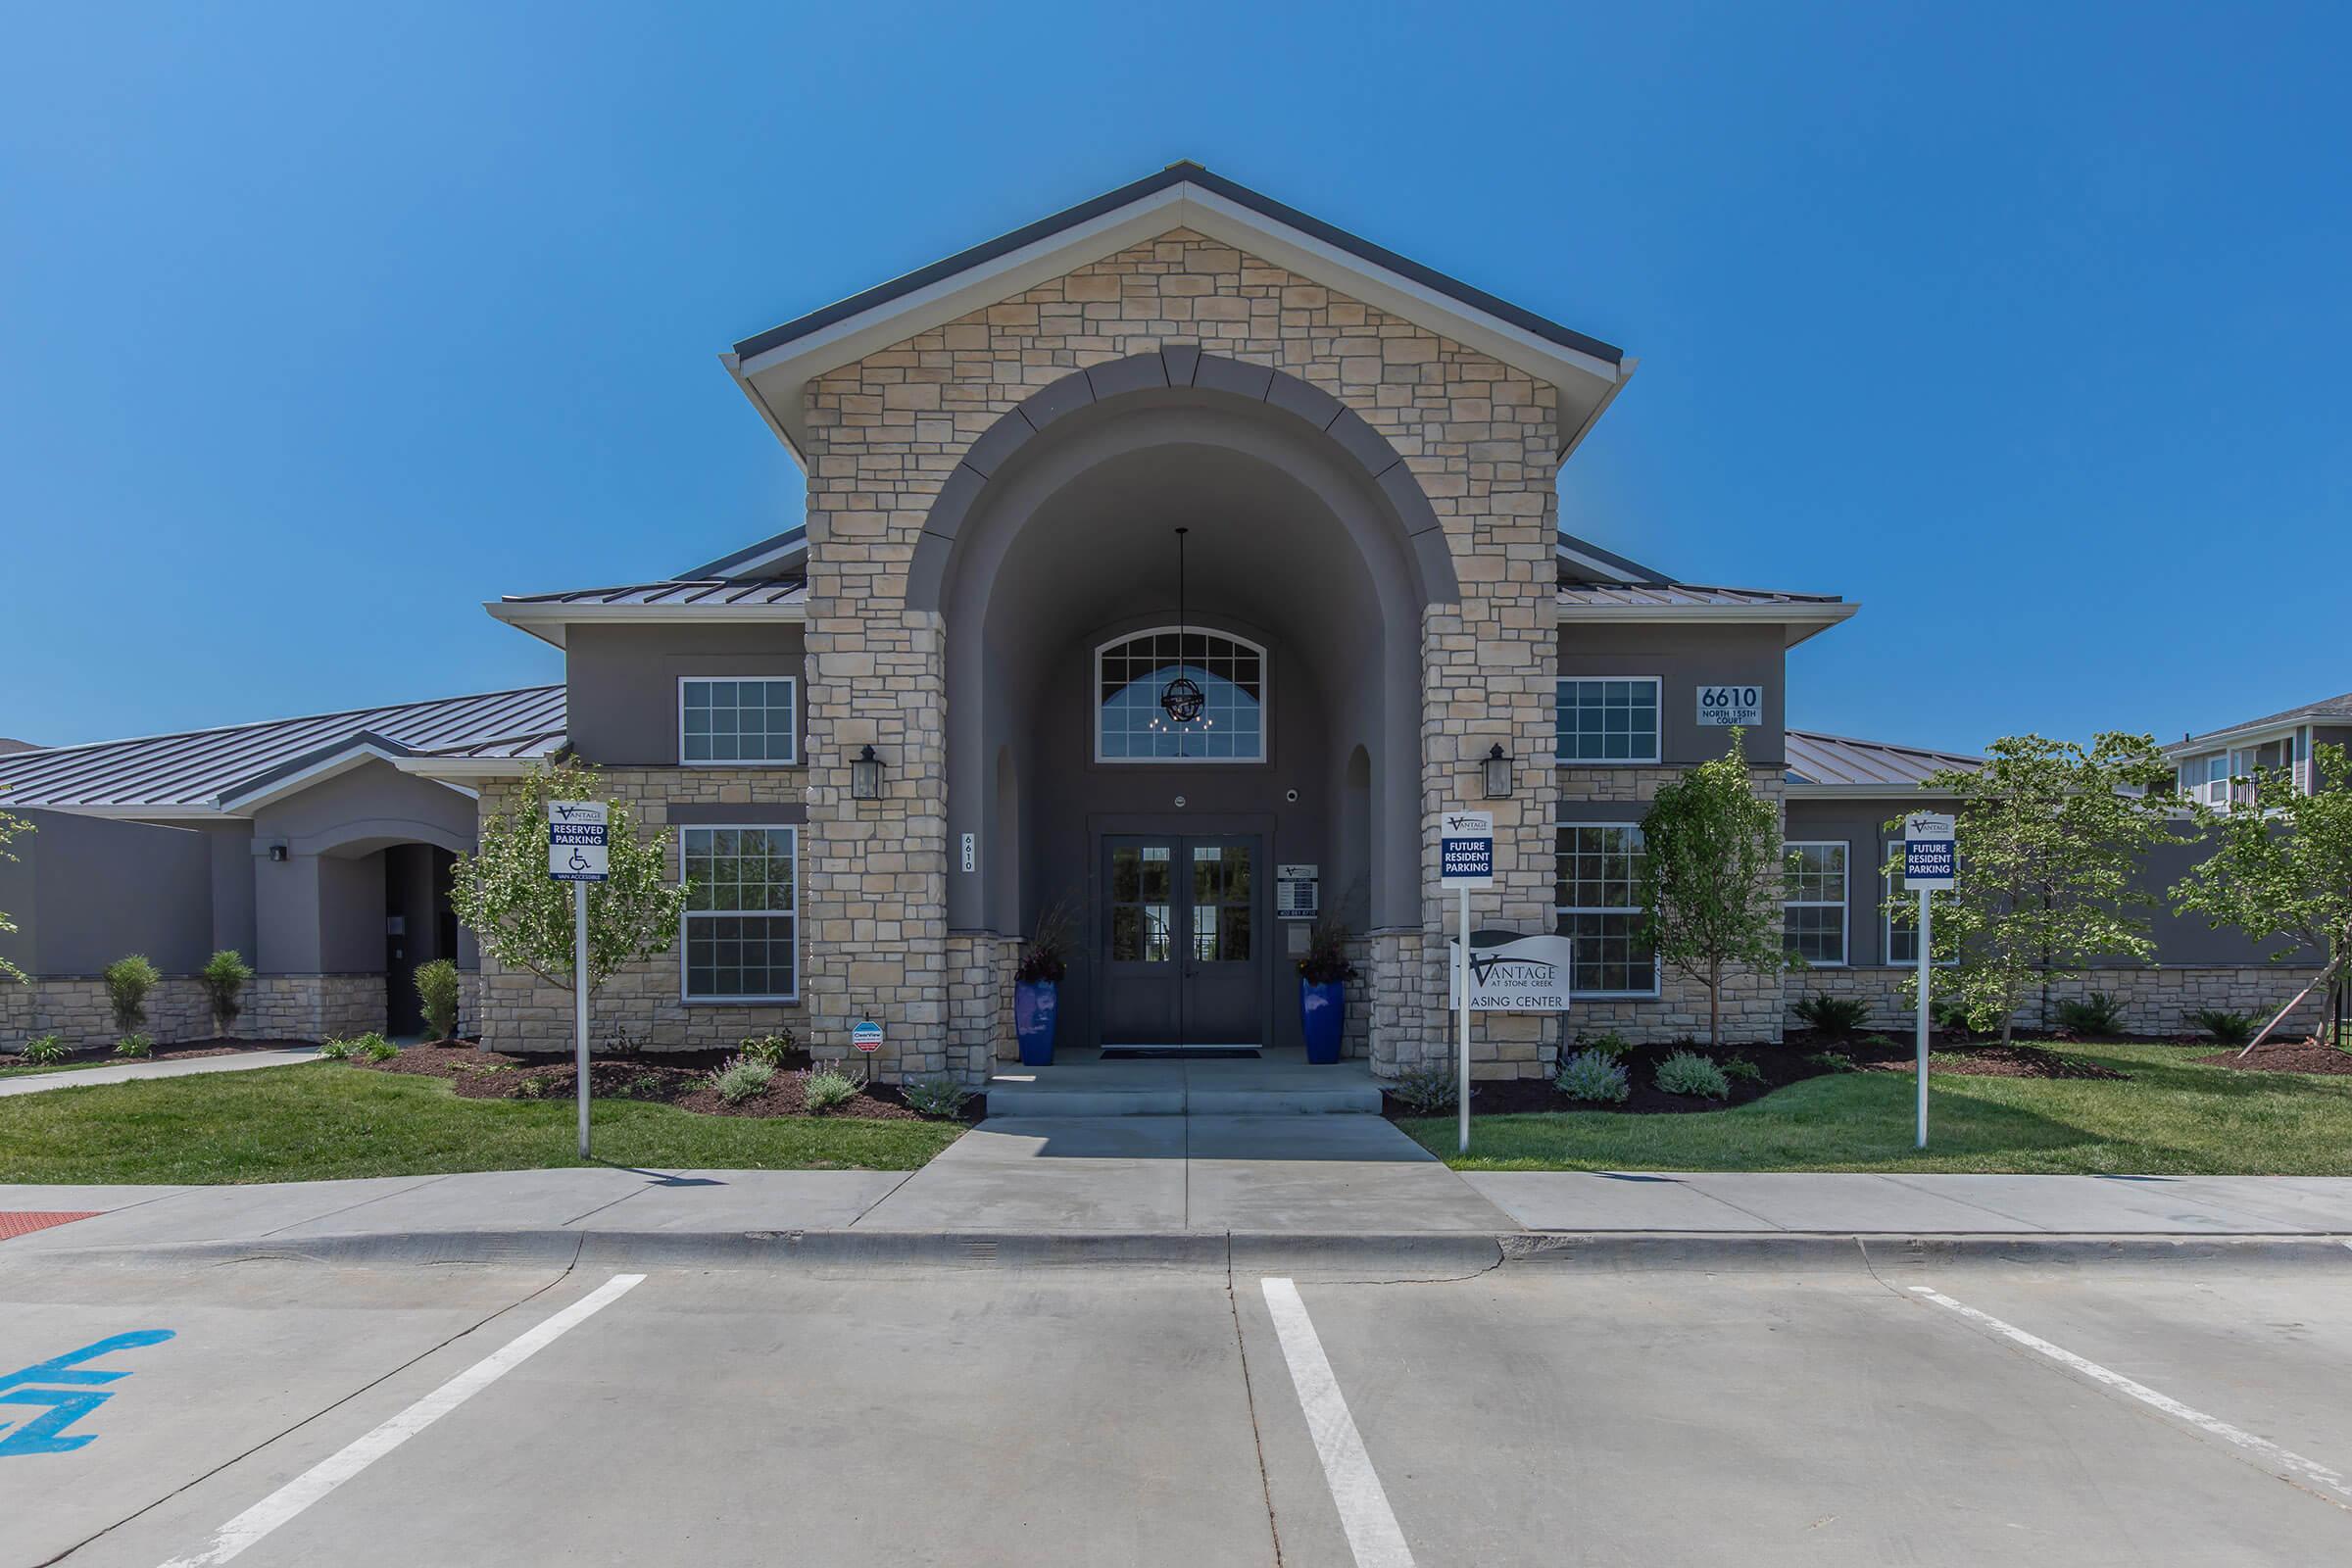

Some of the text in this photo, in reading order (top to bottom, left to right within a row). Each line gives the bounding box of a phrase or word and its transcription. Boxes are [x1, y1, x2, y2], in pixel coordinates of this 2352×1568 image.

[1702, 688, 1756, 707] 6610
[557, 806, 601, 820] VANTAGE
[1448, 816, 1487, 831] VANTAGE
[1912, 819, 1949, 833] VANTAGE
[553, 824, 604, 834] RESERVED
[556, 835, 602, 845] PARKING
[1449, 842, 1485, 851] FUTURE
[1913, 844, 1947, 853] FUTURE
[1445, 853, 1490, 861] RESIDENT
[1908, 855, 1952, 863] RESIDENT
[1446, 862, 1489, 872] PARKING
[1908, 864, 1950, 874] PARKING
[1469, 953, 1556, 988] VANTAGE
[1457, 996, 1562, 1007] ASING CENTER
